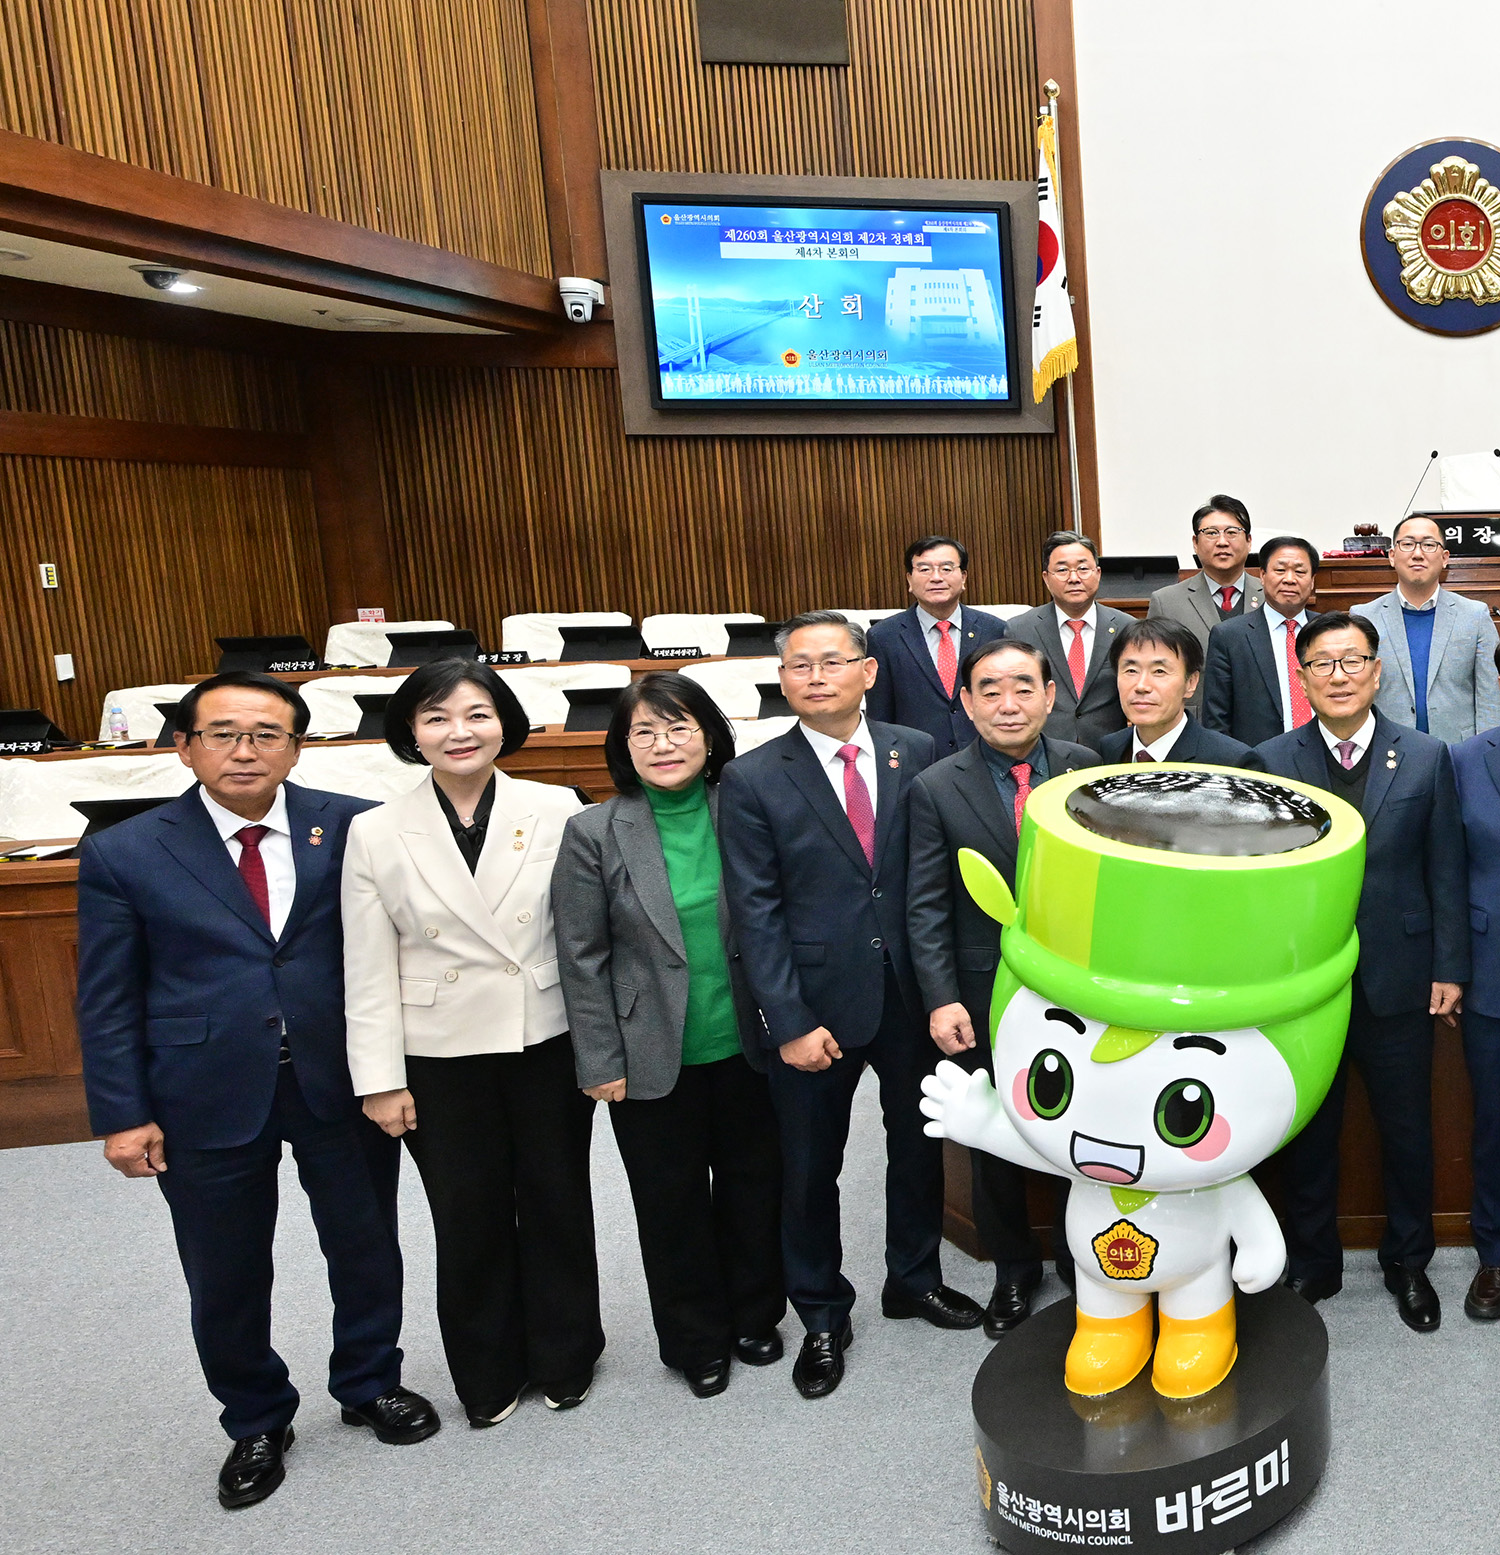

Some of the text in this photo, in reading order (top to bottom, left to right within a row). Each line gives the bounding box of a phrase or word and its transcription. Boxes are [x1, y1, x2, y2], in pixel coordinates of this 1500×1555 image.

[724, 229, 925, 246] 제260회 울산광역시의회 제2차 정례회
[1427, 219, 1485, 252] 의회
[795, 247, 859, 259] 제4차 본회의
[806, 349, 888, 361] 울산광역시의회
[1109, 1246, 1140, 1262] 의회
[1155, 1438, 1290, 1534] 바르미
[996, 1481, 1131, 1533] 울산광역시의회
[1019, 1519, 1086, 1545] METROPOLITAN
[1087, 1535, 1134, 1546] COUNCIL
